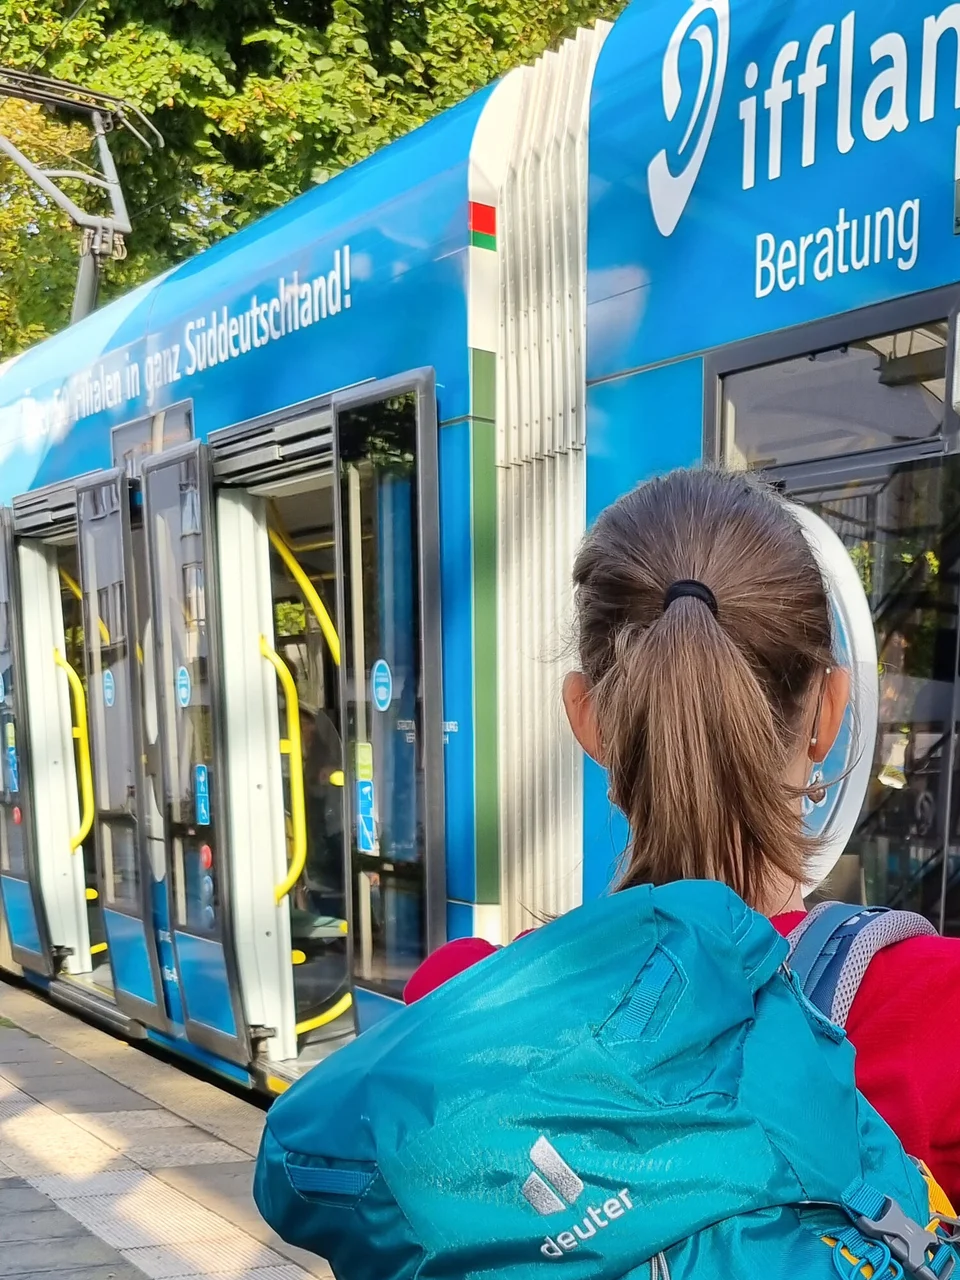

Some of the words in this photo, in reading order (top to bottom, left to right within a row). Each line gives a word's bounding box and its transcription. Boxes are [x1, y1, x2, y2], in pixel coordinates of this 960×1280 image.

[754, 197, 921, 299] Beratung
[125, 352, 141, 400] in
[144, 343, 182, 408] ganz
[184, 244, 352, 377] Süddeutschland!
[540, 1187, 634, 1259] deuter
